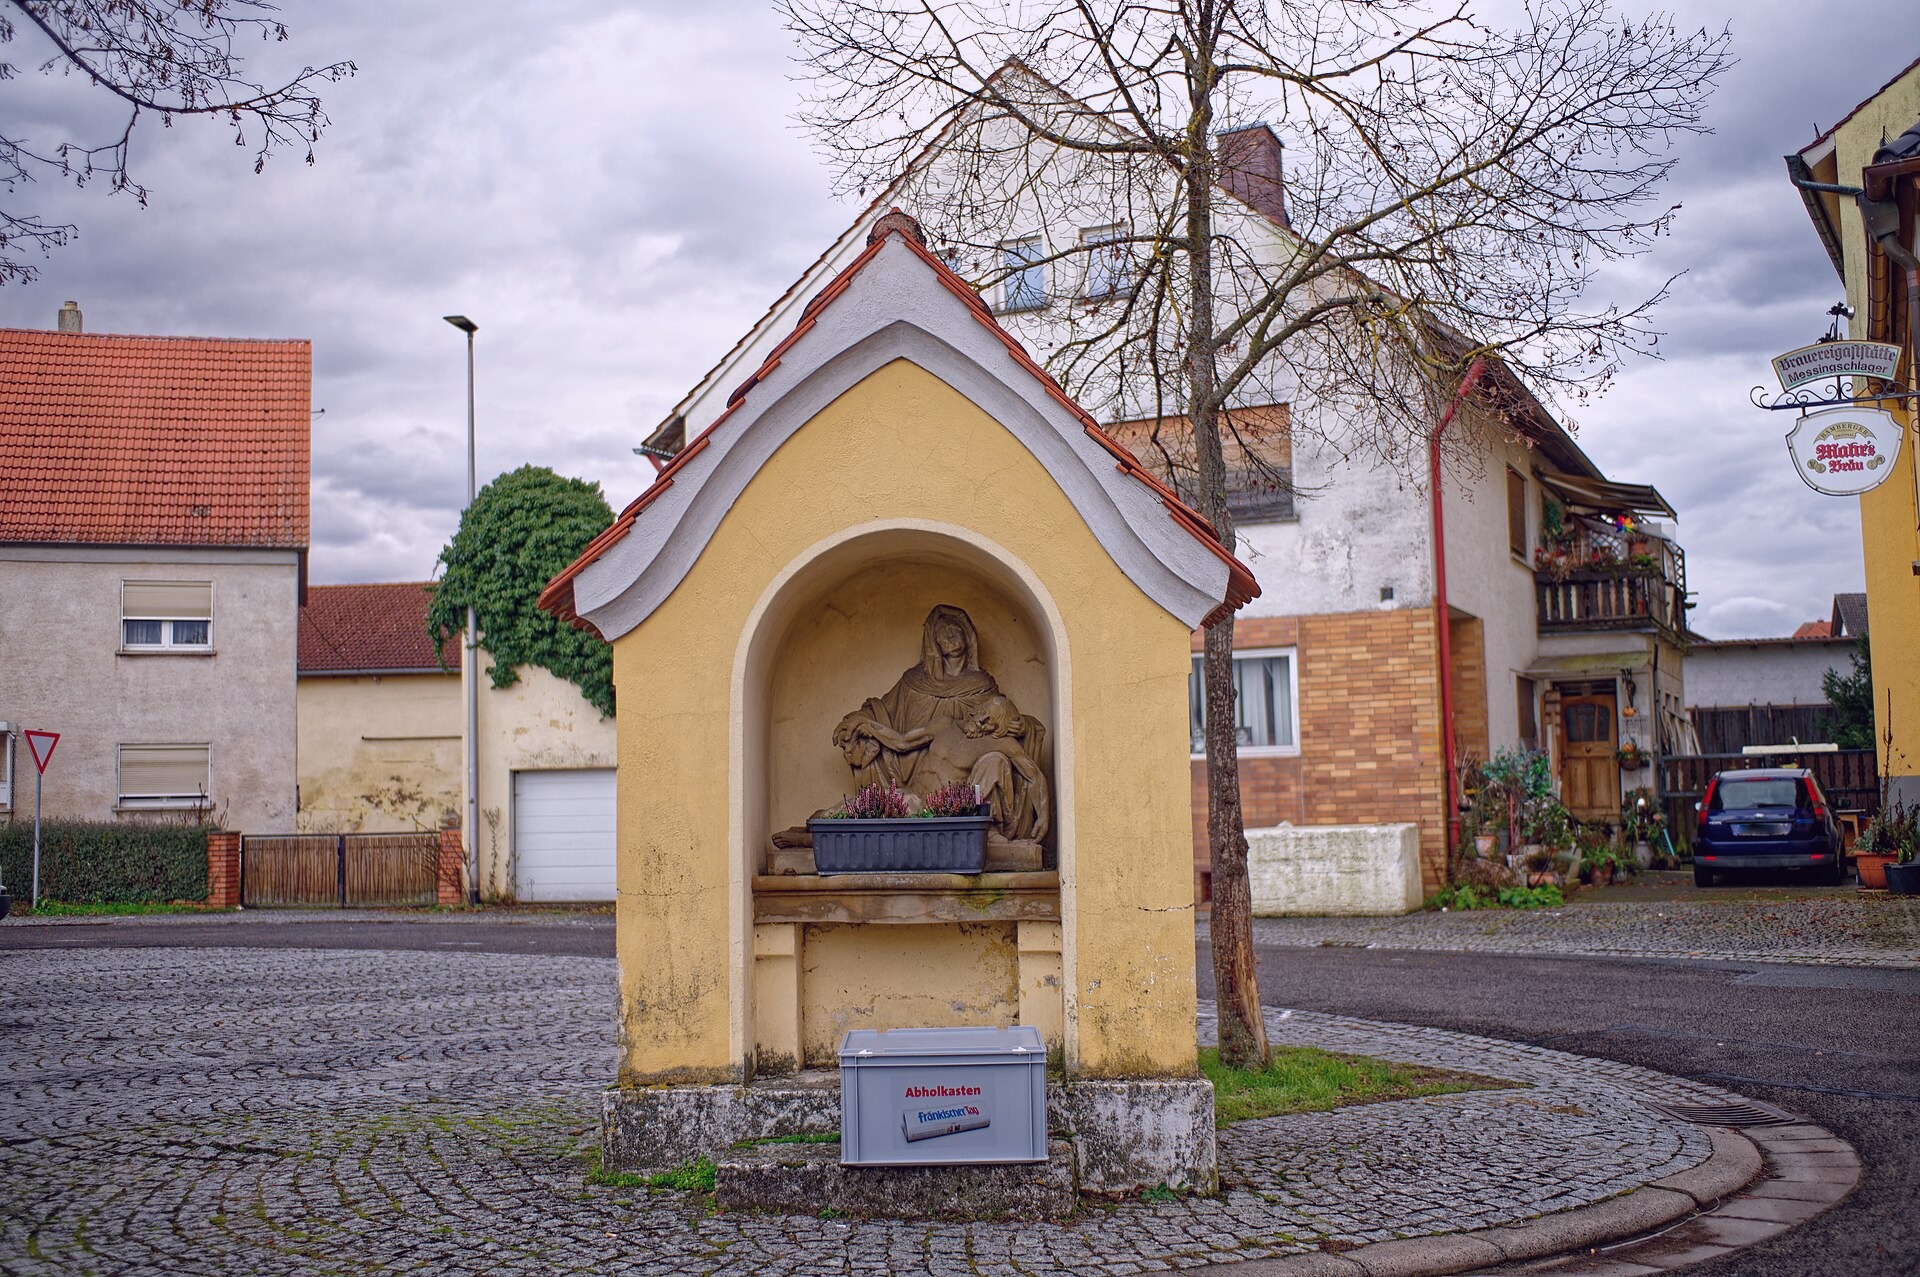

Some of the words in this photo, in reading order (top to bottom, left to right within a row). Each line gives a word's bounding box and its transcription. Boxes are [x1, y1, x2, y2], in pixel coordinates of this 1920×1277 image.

[1788, 361, 1888, 383] Messingschlager
[1820, 423, 1870, 439] BAMBERGER
[1815, 440, 1876, 461] Mahr's
[1828, 459, 1864, 474] Bräu
[905, 1085, 981, 1098] Abholkasten
